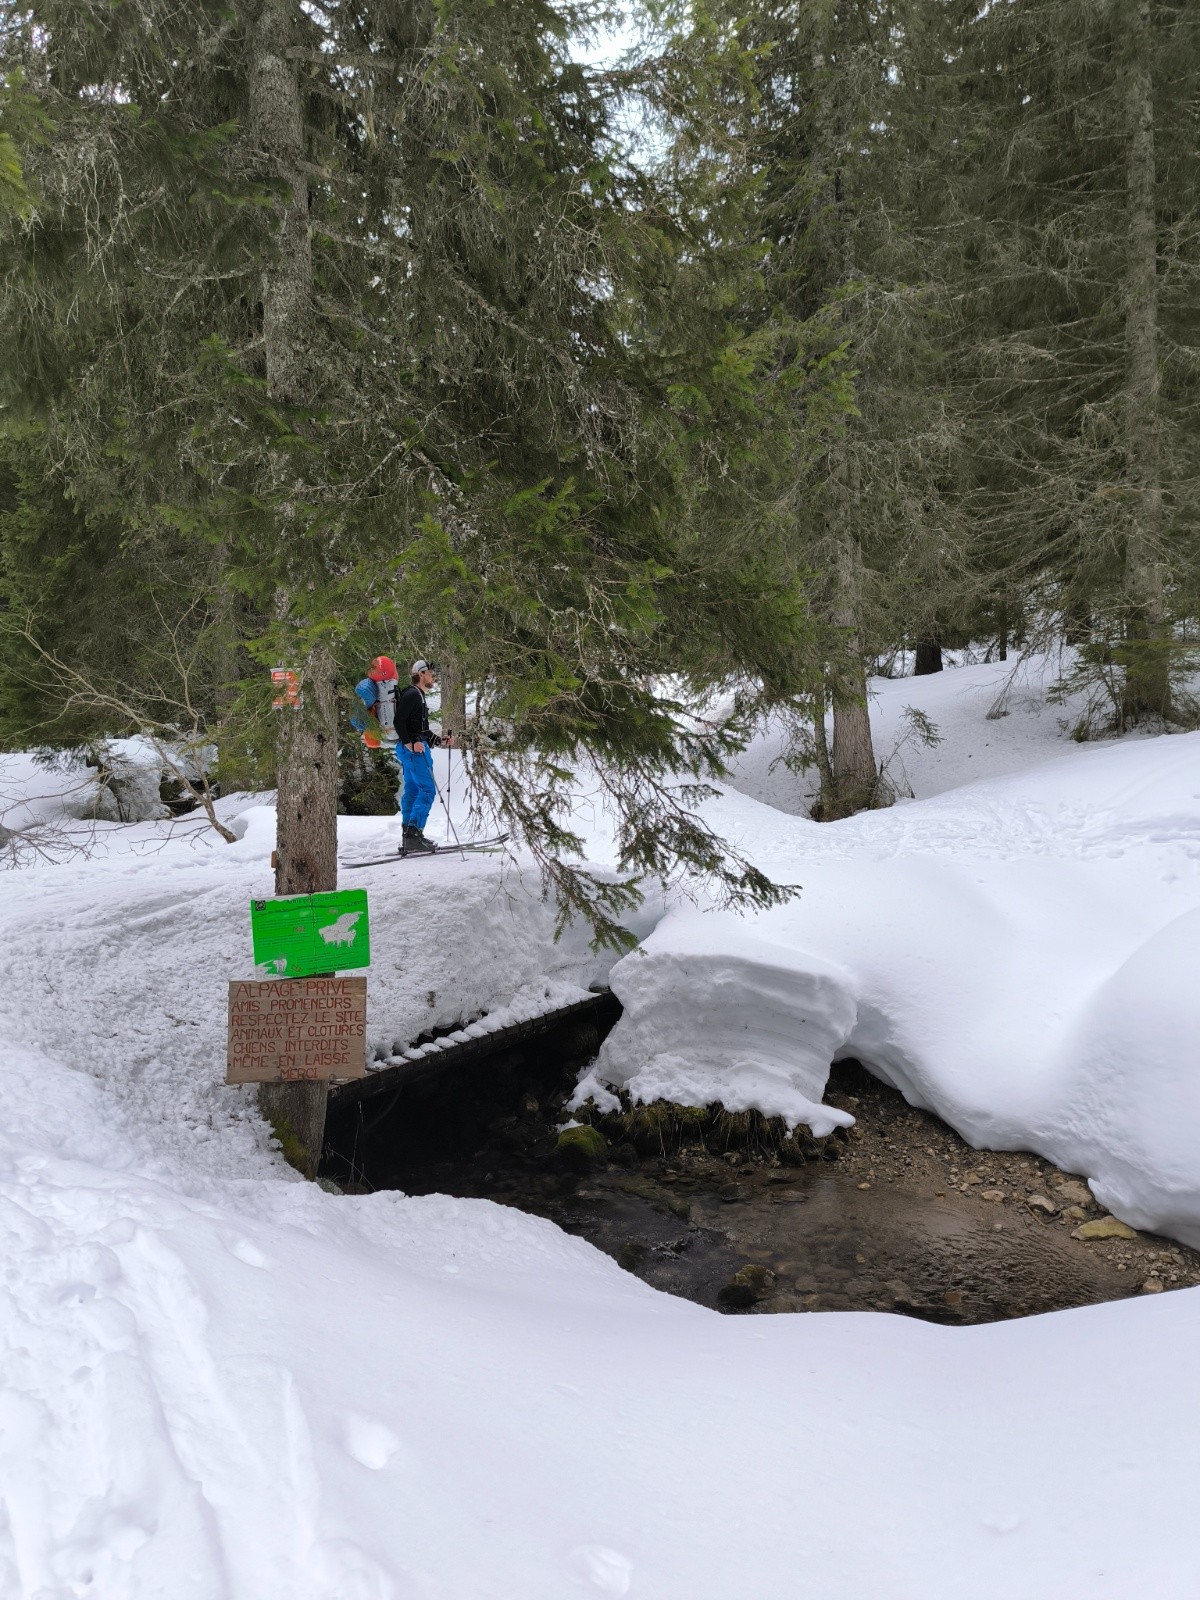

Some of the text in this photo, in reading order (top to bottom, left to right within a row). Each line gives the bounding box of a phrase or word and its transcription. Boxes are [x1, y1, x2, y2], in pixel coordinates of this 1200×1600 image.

[236, 982, 298, 998] ALPAGE
[231, 998, 351, 1012] AMIS PROMENEURS
[232, 1011, 363, 1026] RESPECTEZ LE SITE
[231, 1024, 364, 1042] ANIMAUX ET CLOTURES
[234, 1039, 348, 1054] CHIENS INTERDITS
[233, 1053, 350, 1068] MÊME EN LAISSE
[280, 1068, 317, 1079] MERCI
